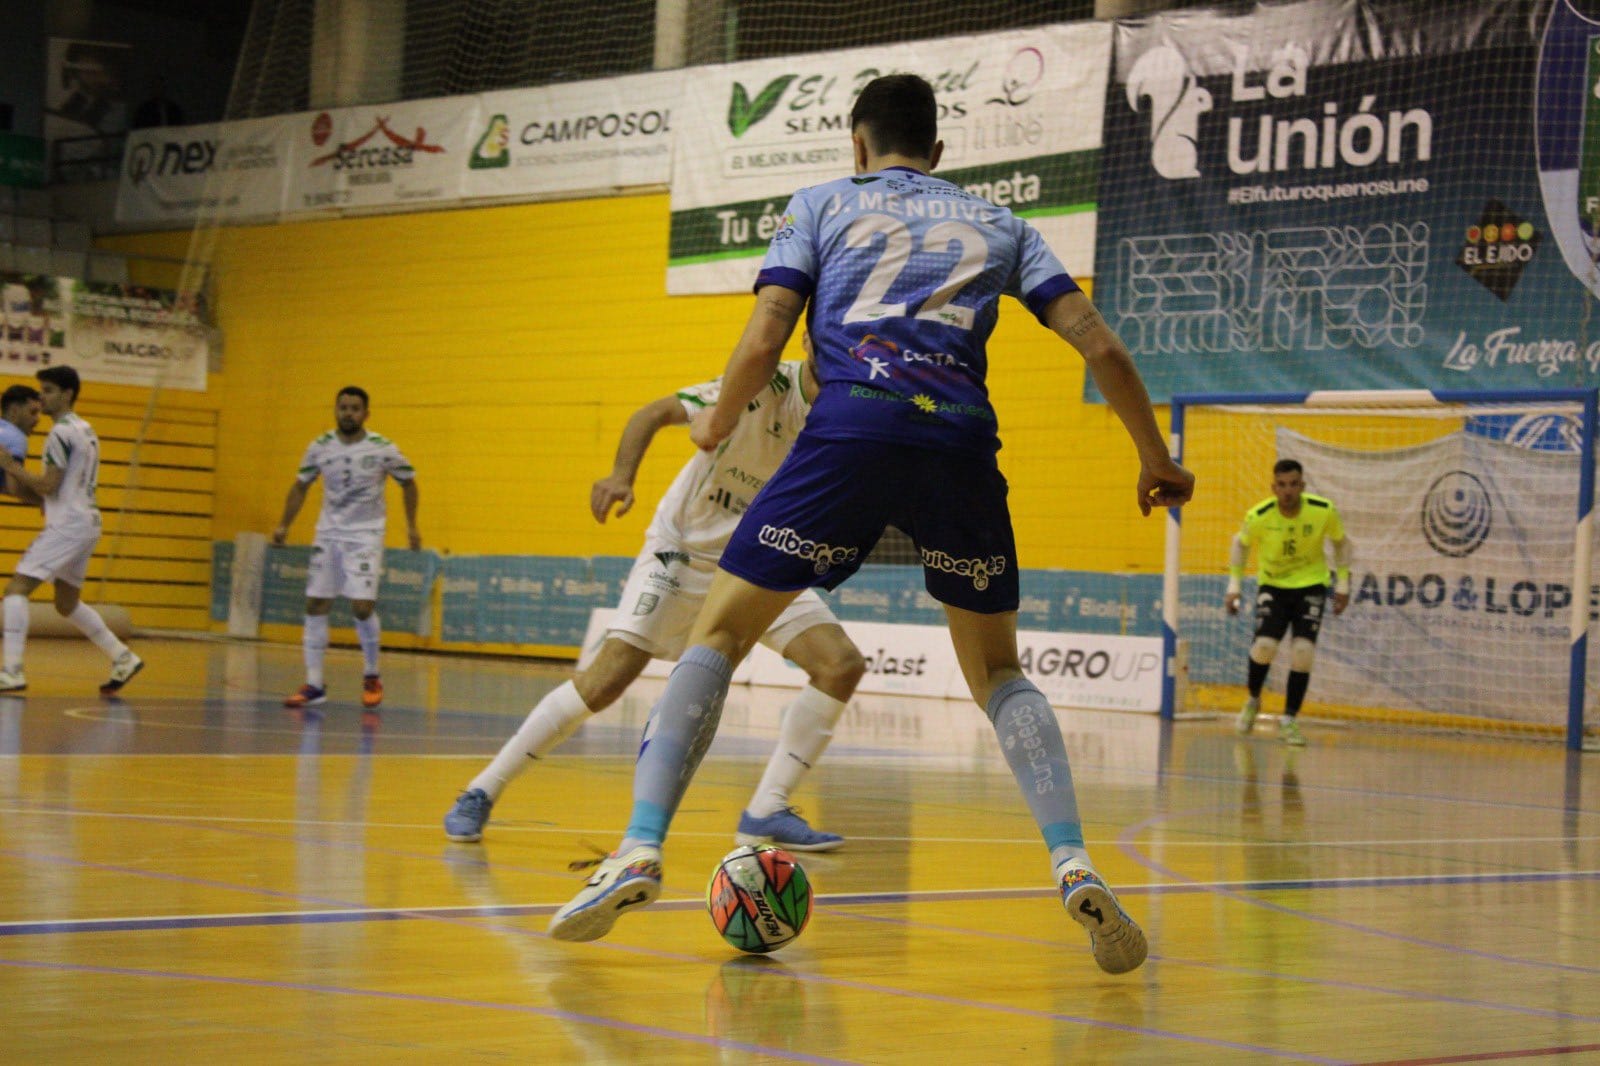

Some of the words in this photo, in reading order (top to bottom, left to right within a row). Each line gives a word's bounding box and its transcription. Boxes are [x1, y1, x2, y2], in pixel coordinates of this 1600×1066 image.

[519, 110, 671, 146] CAMPOSOL
[1227, 96, 1432, 174] unión
[716, 209, 750, 245] Tu
[842, 213, 989, 330] 22
[1442, 331, 1479, 371] La
[1484, 326, 1576, 377] Fuerza
